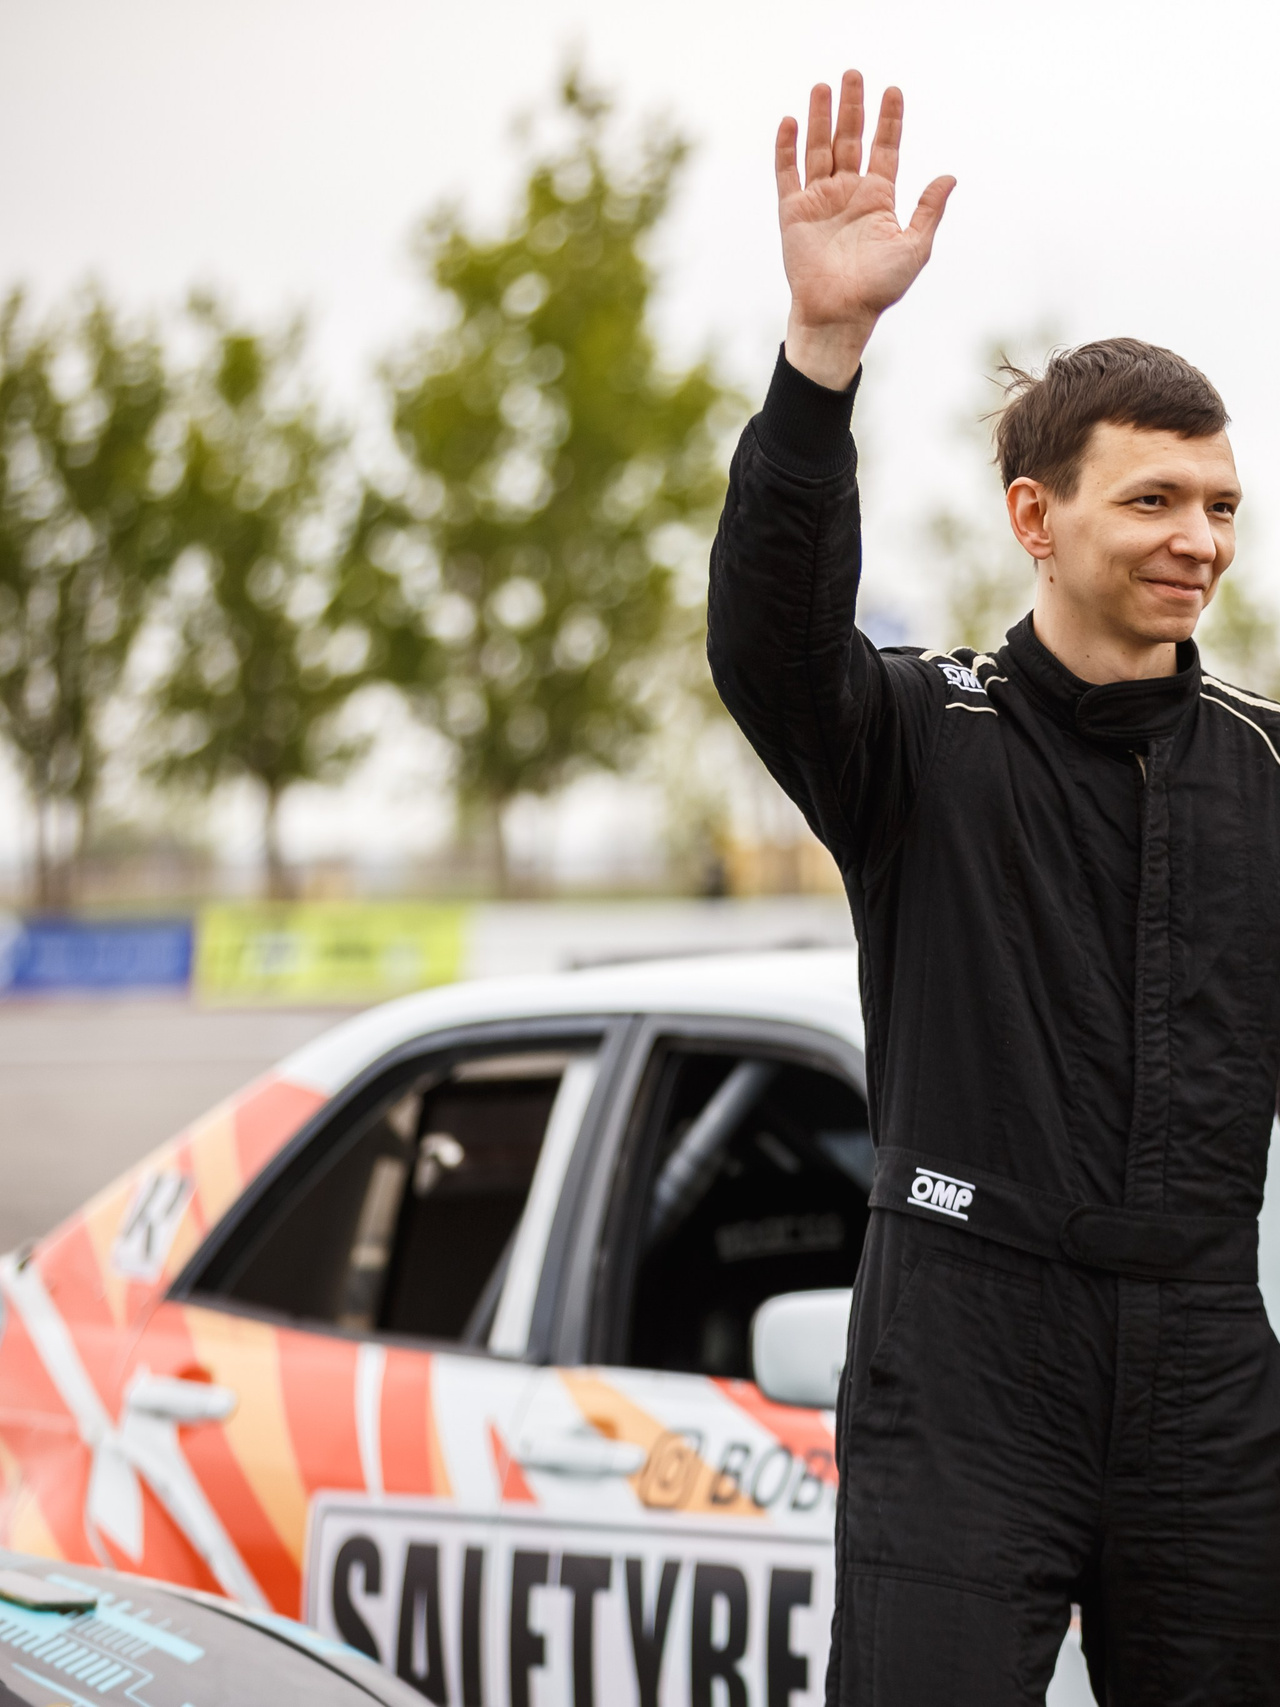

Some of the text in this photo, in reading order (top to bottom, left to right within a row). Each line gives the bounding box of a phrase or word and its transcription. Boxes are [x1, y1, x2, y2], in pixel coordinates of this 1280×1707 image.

[941, 666, 984, 690] OM
[911, 1175, 974, 1213] OMP
[709, 1441, 838, 1511] BOB
